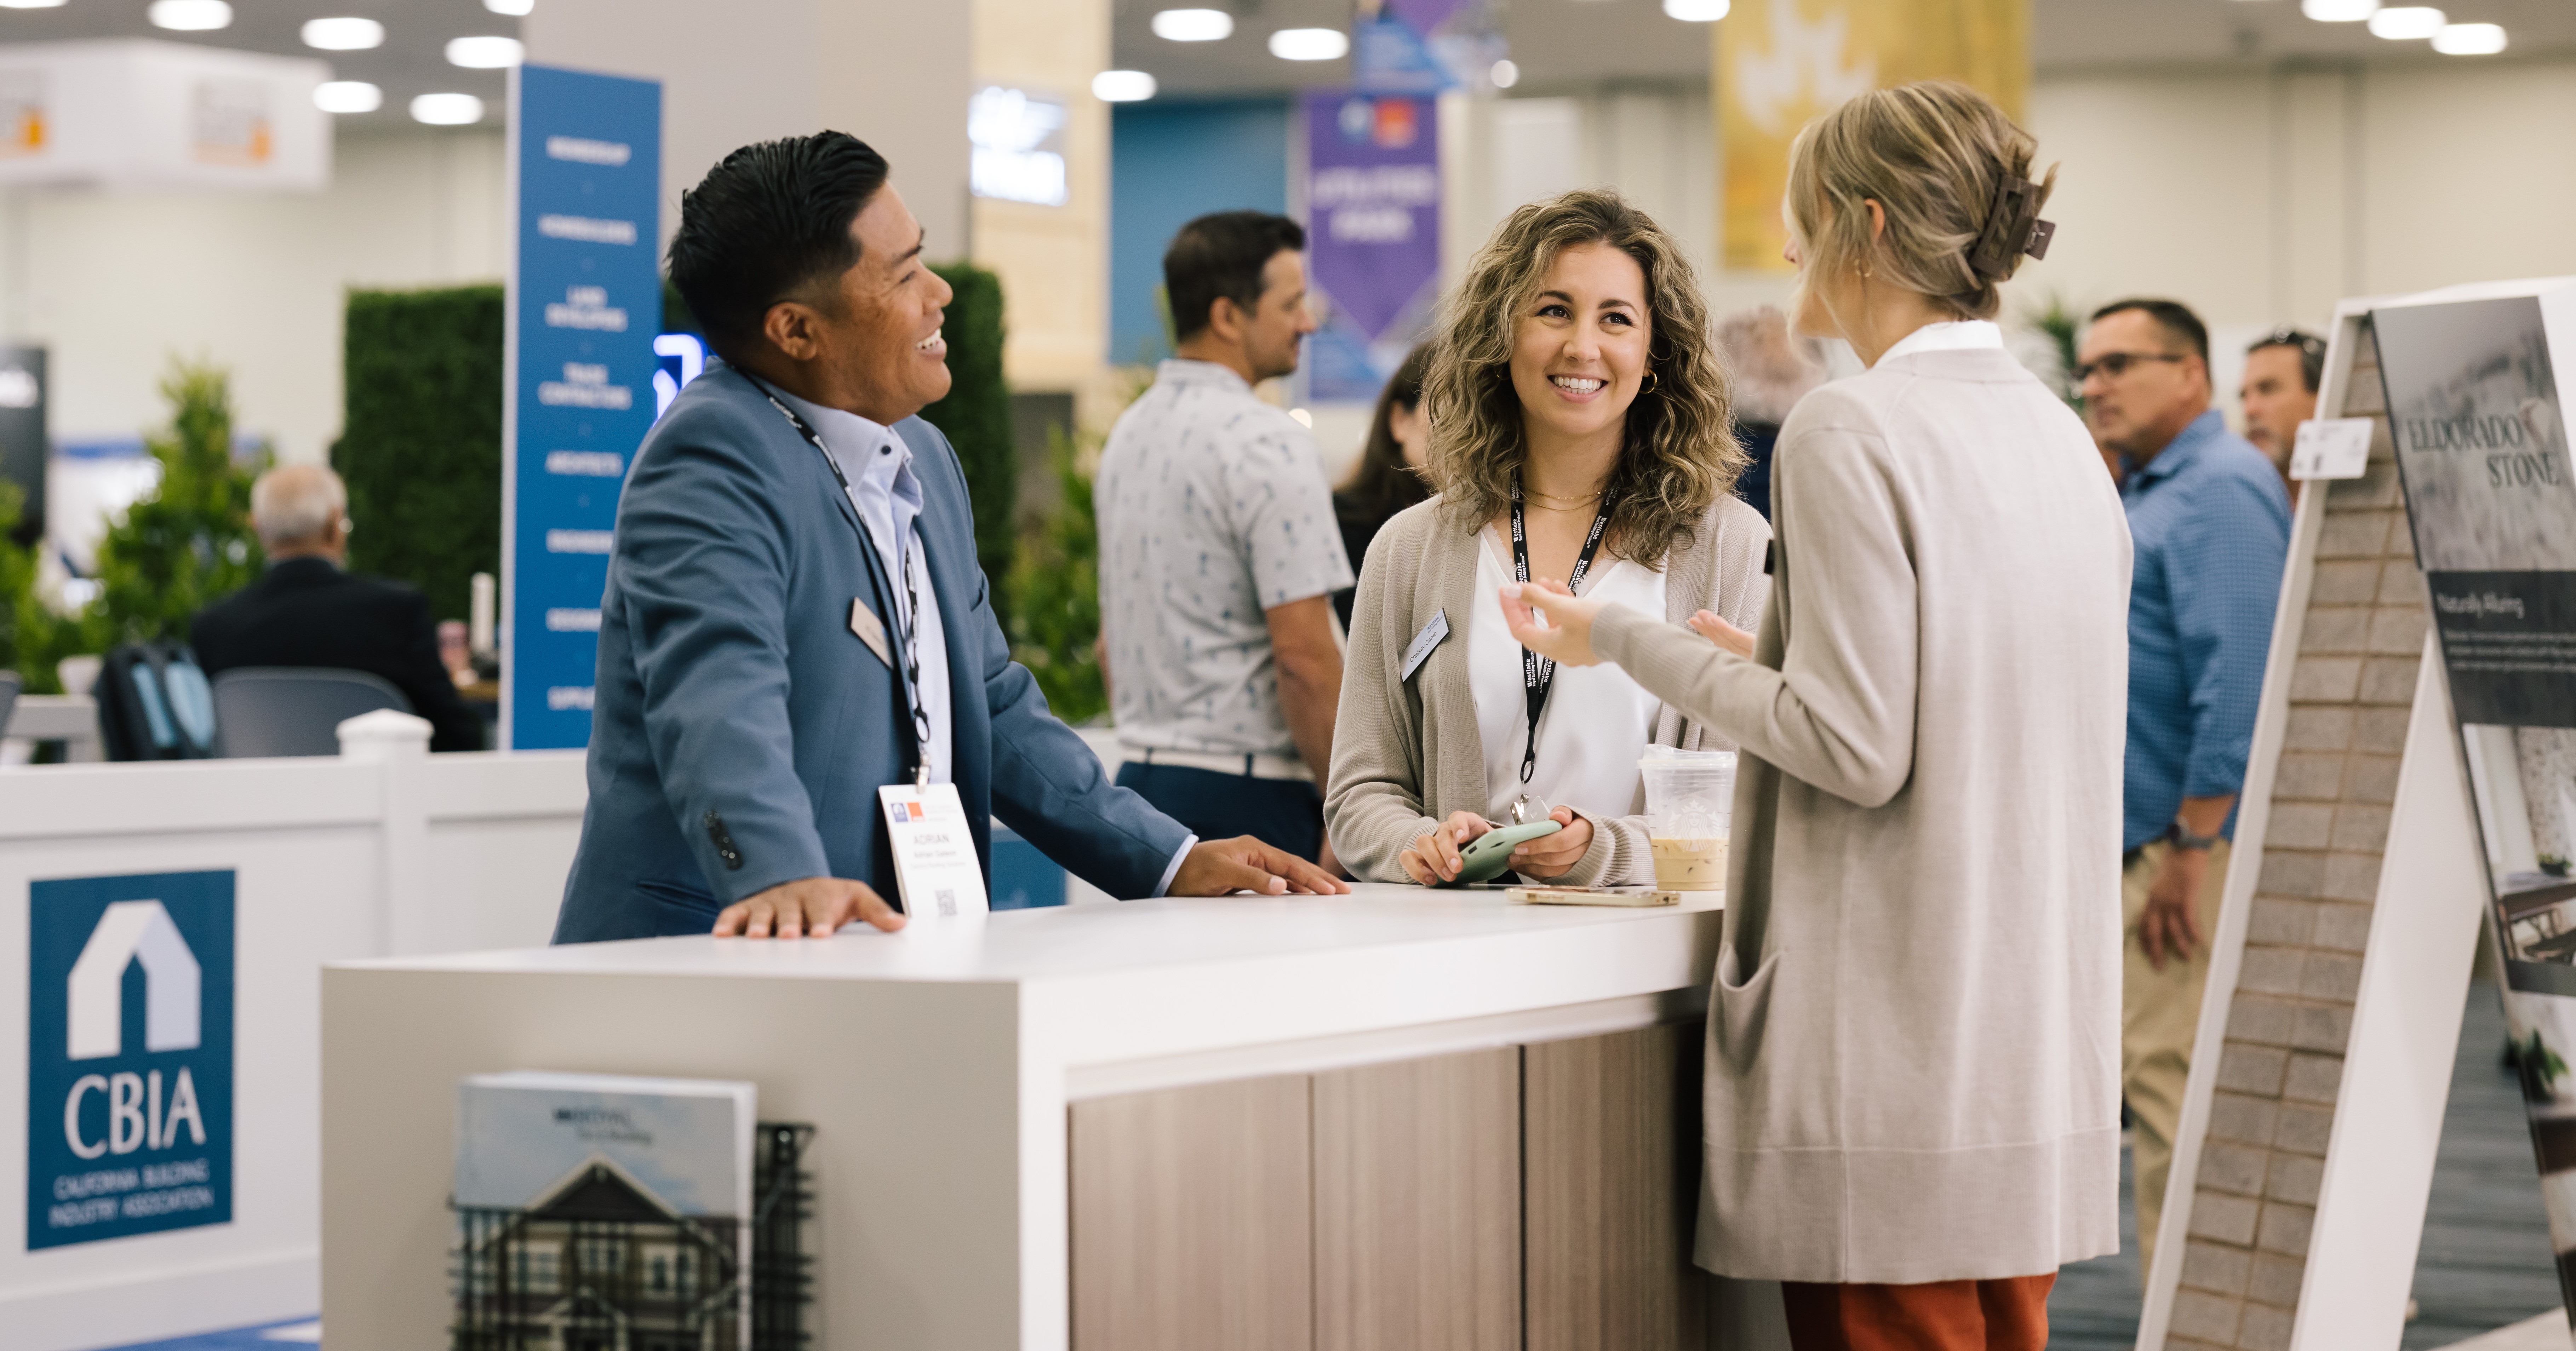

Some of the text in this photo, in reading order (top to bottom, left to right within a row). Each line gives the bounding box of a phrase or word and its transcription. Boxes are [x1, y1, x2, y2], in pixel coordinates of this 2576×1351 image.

[2408, 414, 2524, 452] ELDORADO
[2486, 452, 2560, 488] STONE
[1593, 518, 1607, 539] Westlake
[1574, 561, 1588, 583] Westlake
[2437, 592, 2524, 619] Naturally Alluring
[1410, 632, 1437, 662] Chelsey Canto
[64, 1066, 206, 1160] CBIA
[53, 1159, 209, 1200] CALIFORNIA BUILDING
[48, 1186, 214, 1228] INDUSTRY ASSOCIATION
